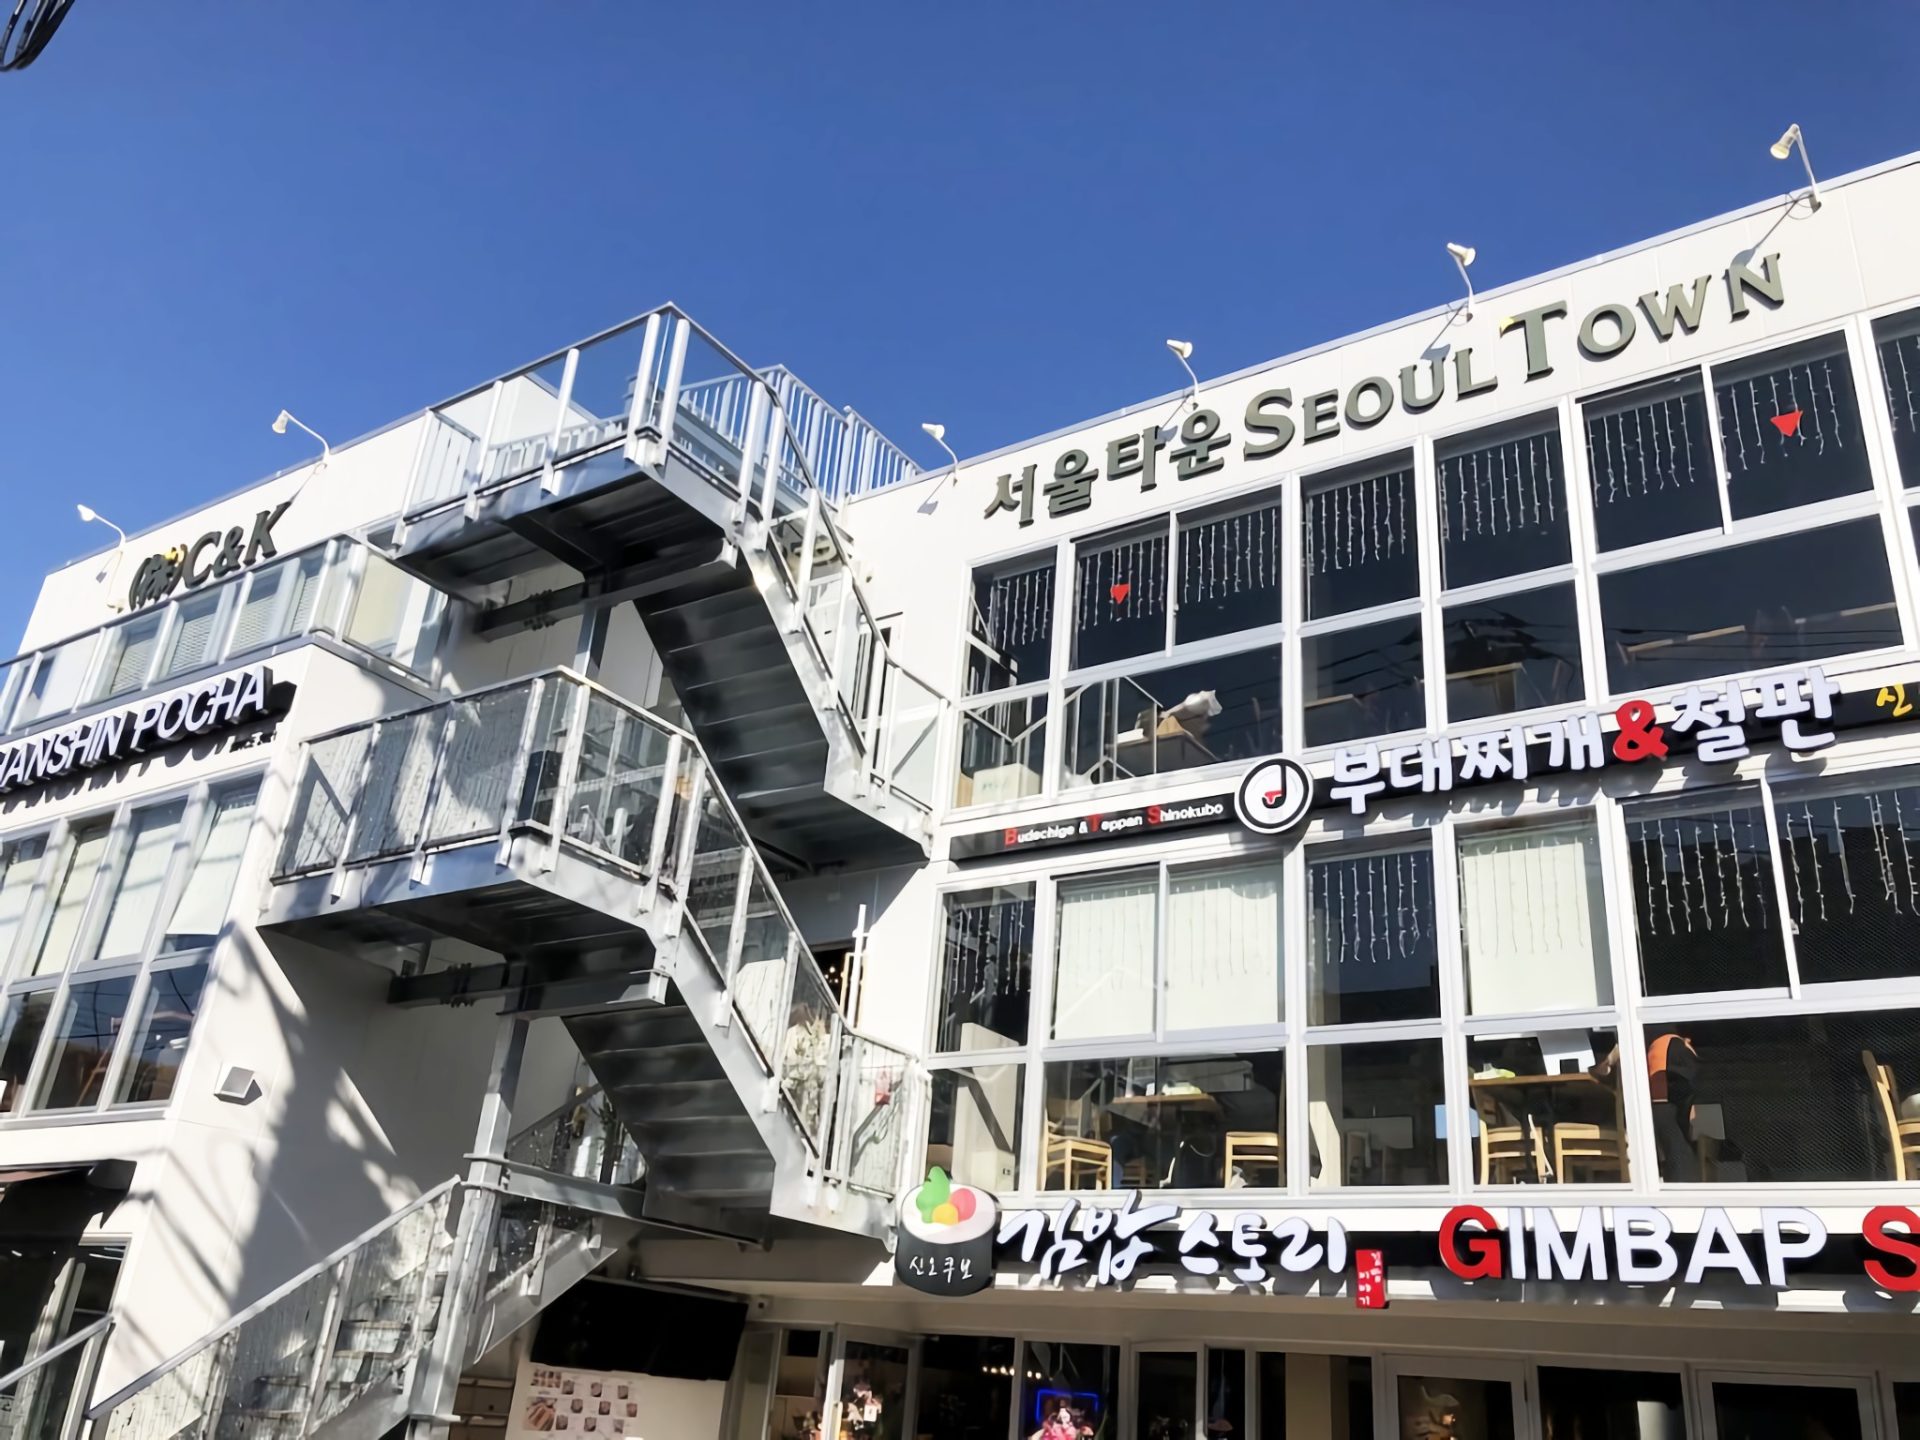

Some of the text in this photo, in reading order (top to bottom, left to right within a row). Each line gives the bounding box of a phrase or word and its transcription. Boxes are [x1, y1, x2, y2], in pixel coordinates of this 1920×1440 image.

[984, 409, 1232, 529] 서울타운
[130, 665, 268, 750] POCHA
[1438, 1204, 1828, 1286] GIMBAP
